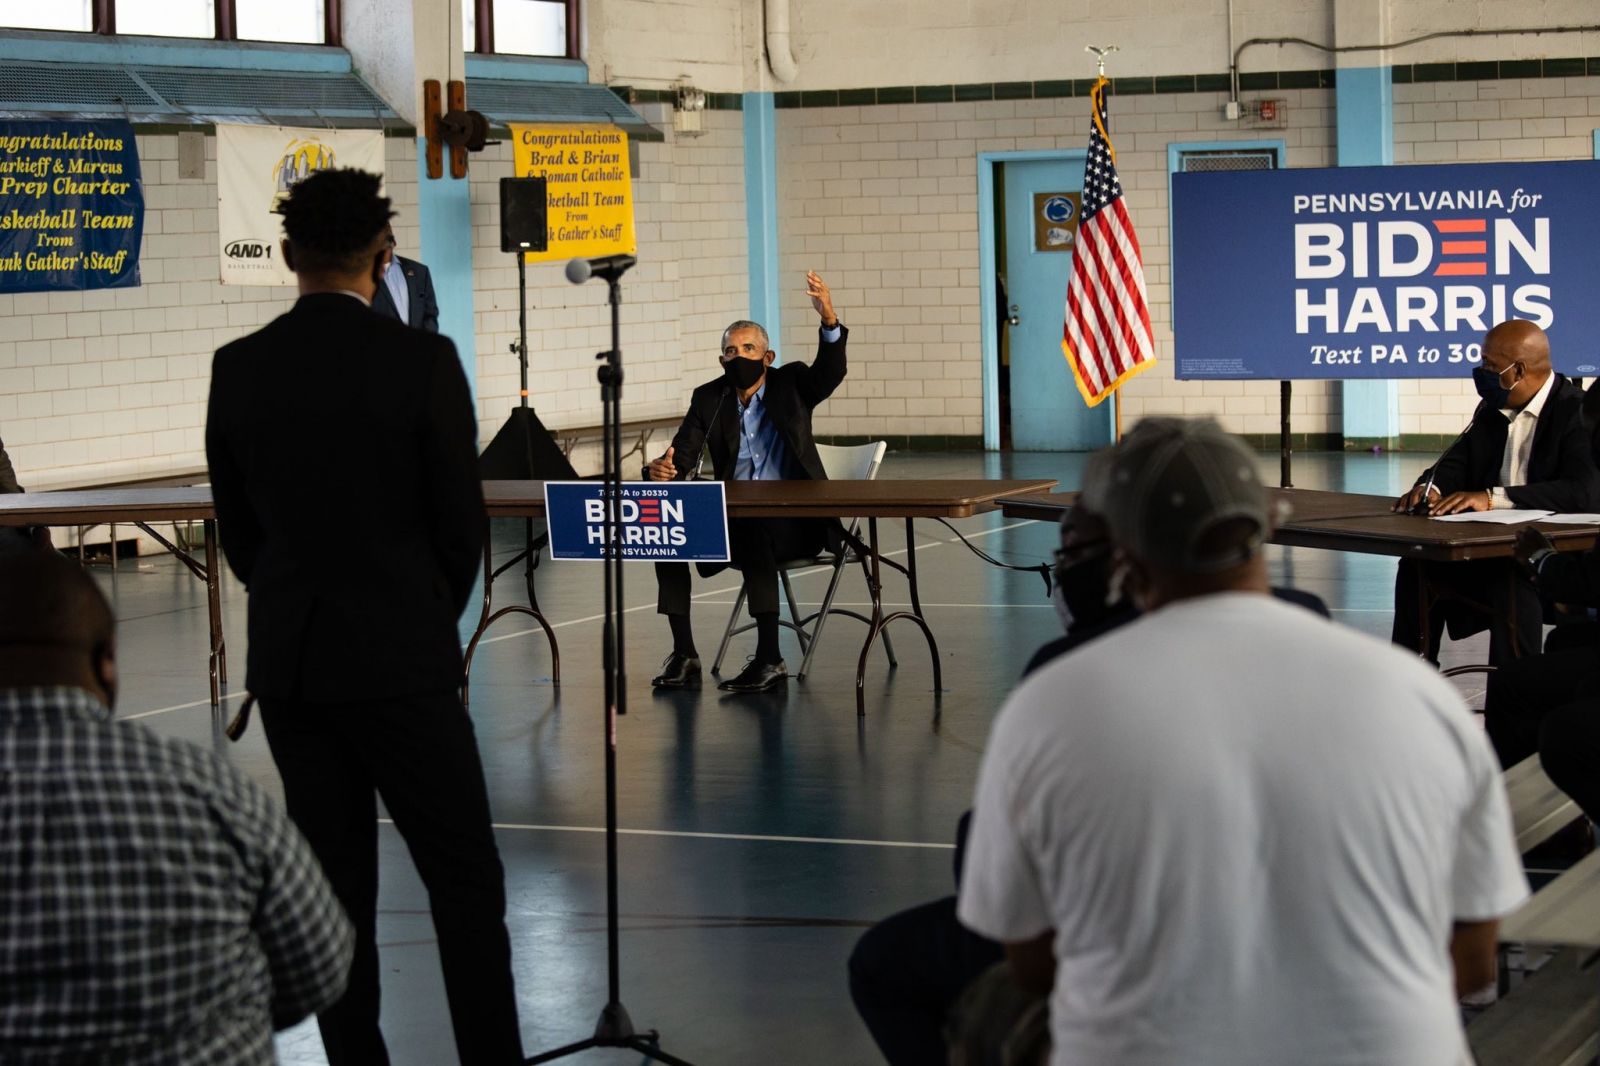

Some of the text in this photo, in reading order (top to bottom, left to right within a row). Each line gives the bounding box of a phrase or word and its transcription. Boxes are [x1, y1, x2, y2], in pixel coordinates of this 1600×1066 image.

[0, 132, 123, 153] ngratulations
[522, 130, 621, 147] Congratulations
[0, 157, 123, 177] arkieff & Marcus
[531, 150, 620, 166] Brad & Brian
[581, 166, 624, 182] Catholic
[0, 177, 131, 199] Prep Charter
[548, 192, 624, 207] ketball Team
[1294, 188, 1542, 214] PENNSYLVANIA for
[82, 210, 134, 229] Team
[566, 211, 588, 221] From
[37, 233, 74, 247] From
[558, 226, 597, 241] Gather's
[600, 223, 622, 242] Staff
[229, 243, 272, 259] AND 1
[1294, 217, 1551, 279] BIDEN
[0, 250, 127, 274] ank Gather's Staff
[1295, 284, 1554, 334] HARRIS
[1311, 343, 1482, 365] Text PA to 30
[641, 489, 669, 497] 30330
[585, 499, 684, 523] BIDEN
[600, 547, 678, 556] PNSYLVANIA
